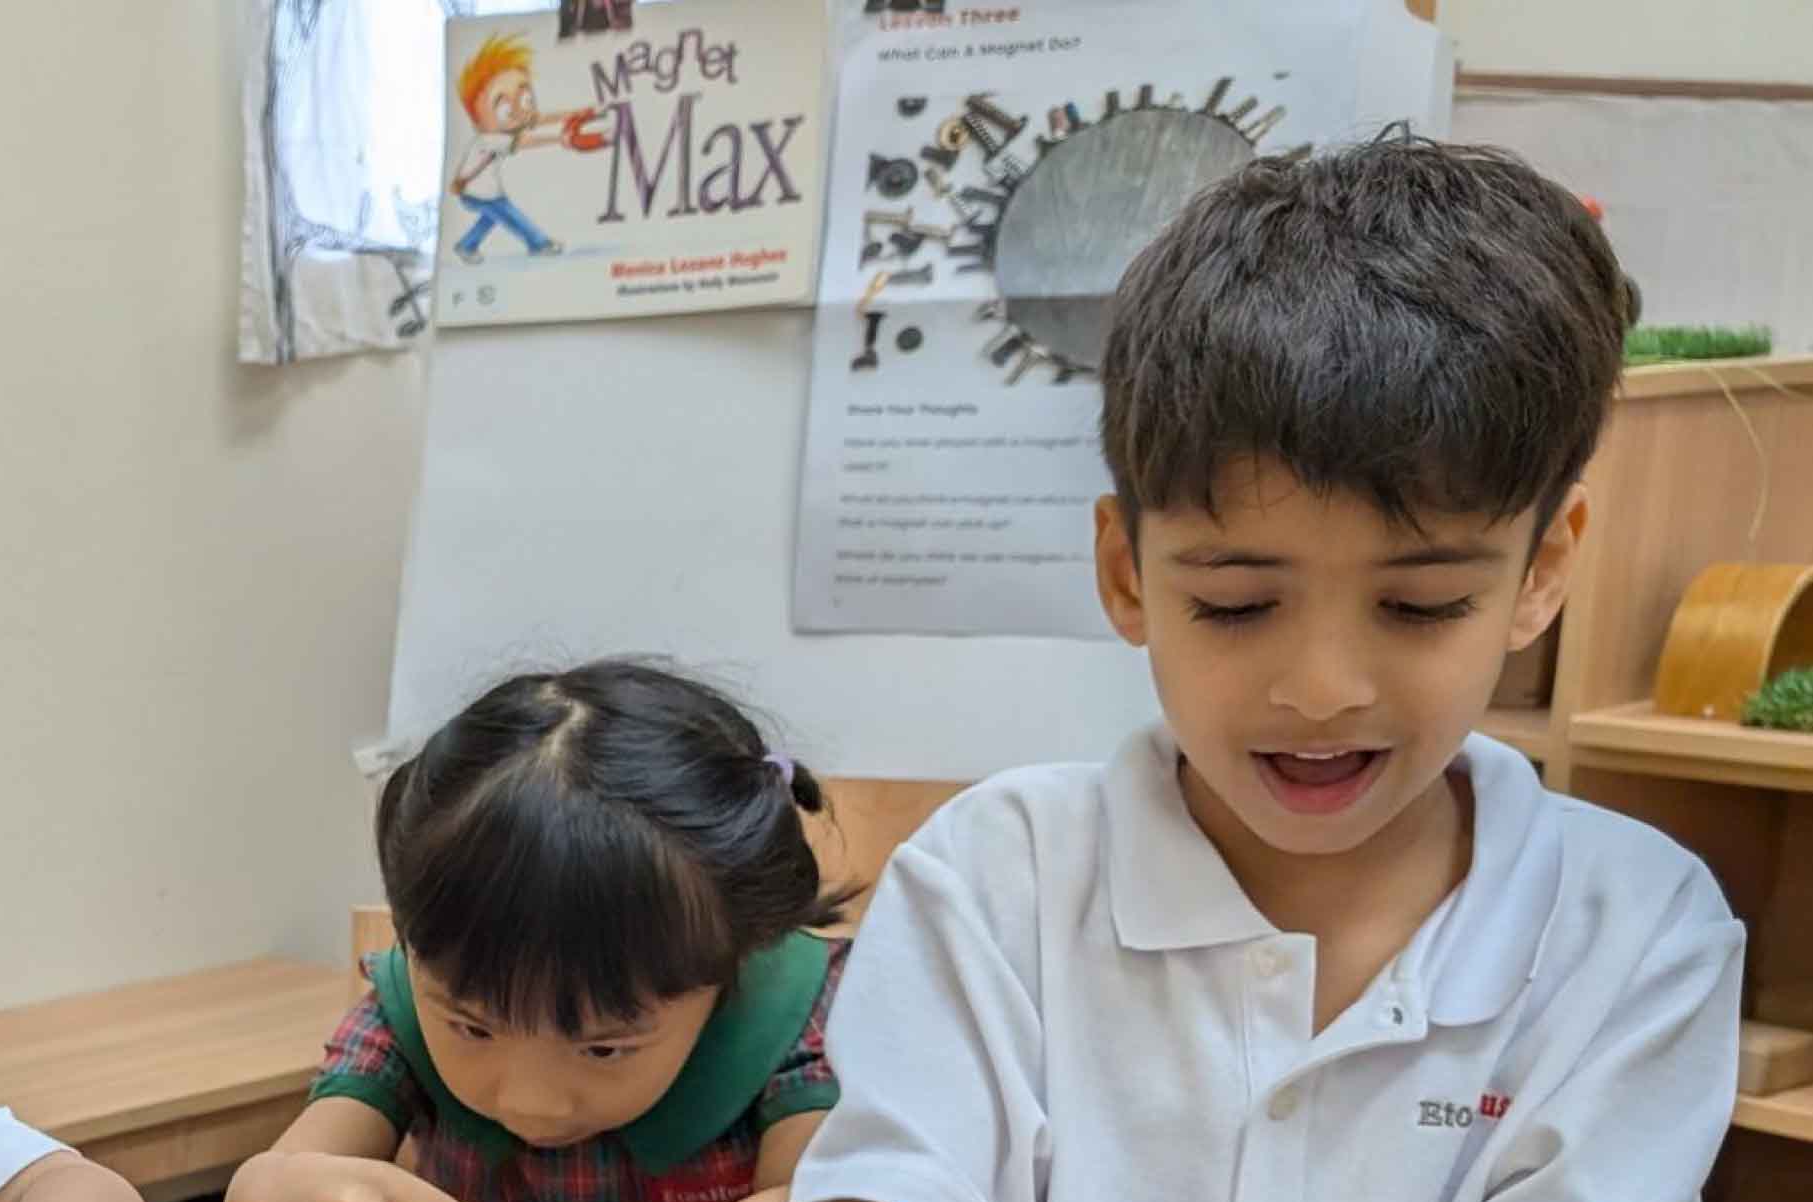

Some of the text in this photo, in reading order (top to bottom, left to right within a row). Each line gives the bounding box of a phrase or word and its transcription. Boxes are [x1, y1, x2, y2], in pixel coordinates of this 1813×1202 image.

[961, 8, 1020, 26] Three
[590, 28, 739, 104] Magnet
[878, 47, 919, 62] What
[979, 40, 1043, 60] Magnet
[597, 92, 804, 225] Max
